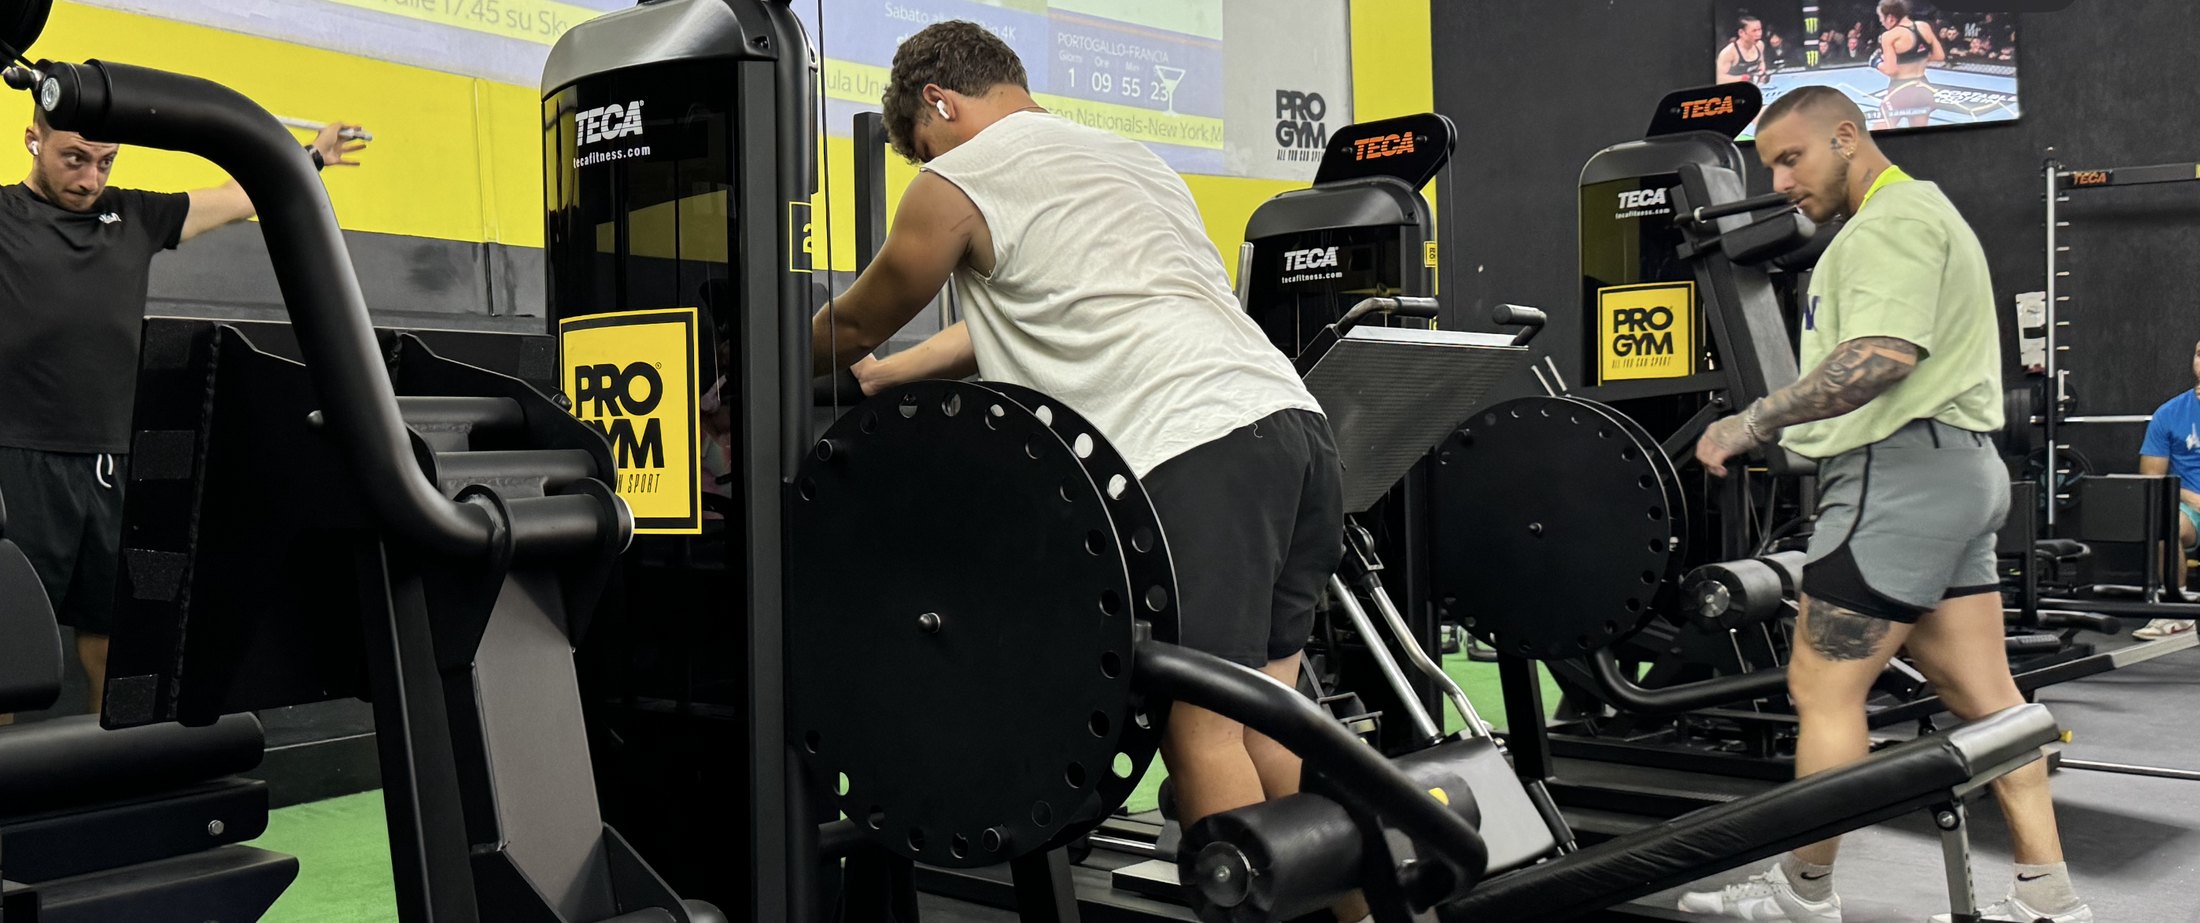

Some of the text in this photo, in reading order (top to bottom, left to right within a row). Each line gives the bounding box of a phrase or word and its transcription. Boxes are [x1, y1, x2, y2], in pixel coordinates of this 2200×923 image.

[506, 9, 532, 32] su
[885, 3, 929, 22] Sabato
[1057, 32, 1169, 64] PORTOGALLO-FRANCIA
[1068, 67, 1169, 102] 1 09 55 23
[1276, 89, 1327, 121] PRO
[1680, 95, 1734, 120] TECA
[575, 100, 644, 147] TECA
[1180, 122, 1209, 141] York
[1275, 119, 1327, 149] GYM
[573, 146, 651, 169] tecafitness.com
[1354, 131, 1415, 161] TECA
[2072, 171, 2107, 186] TECA
[1617, 187, 1668, 209] TECA
[1284, 246, 1339, 272] TECA
[1281, 271, 1343, 284] tecafitness.com
[1613, 306, 1674, 334] PRO
[1612, 332, 1674, 357] GYM
[575, 361, 663, 418] PRO
[580, 418, 665, 469] YM
[628, 473, 660, 494] SPORT
